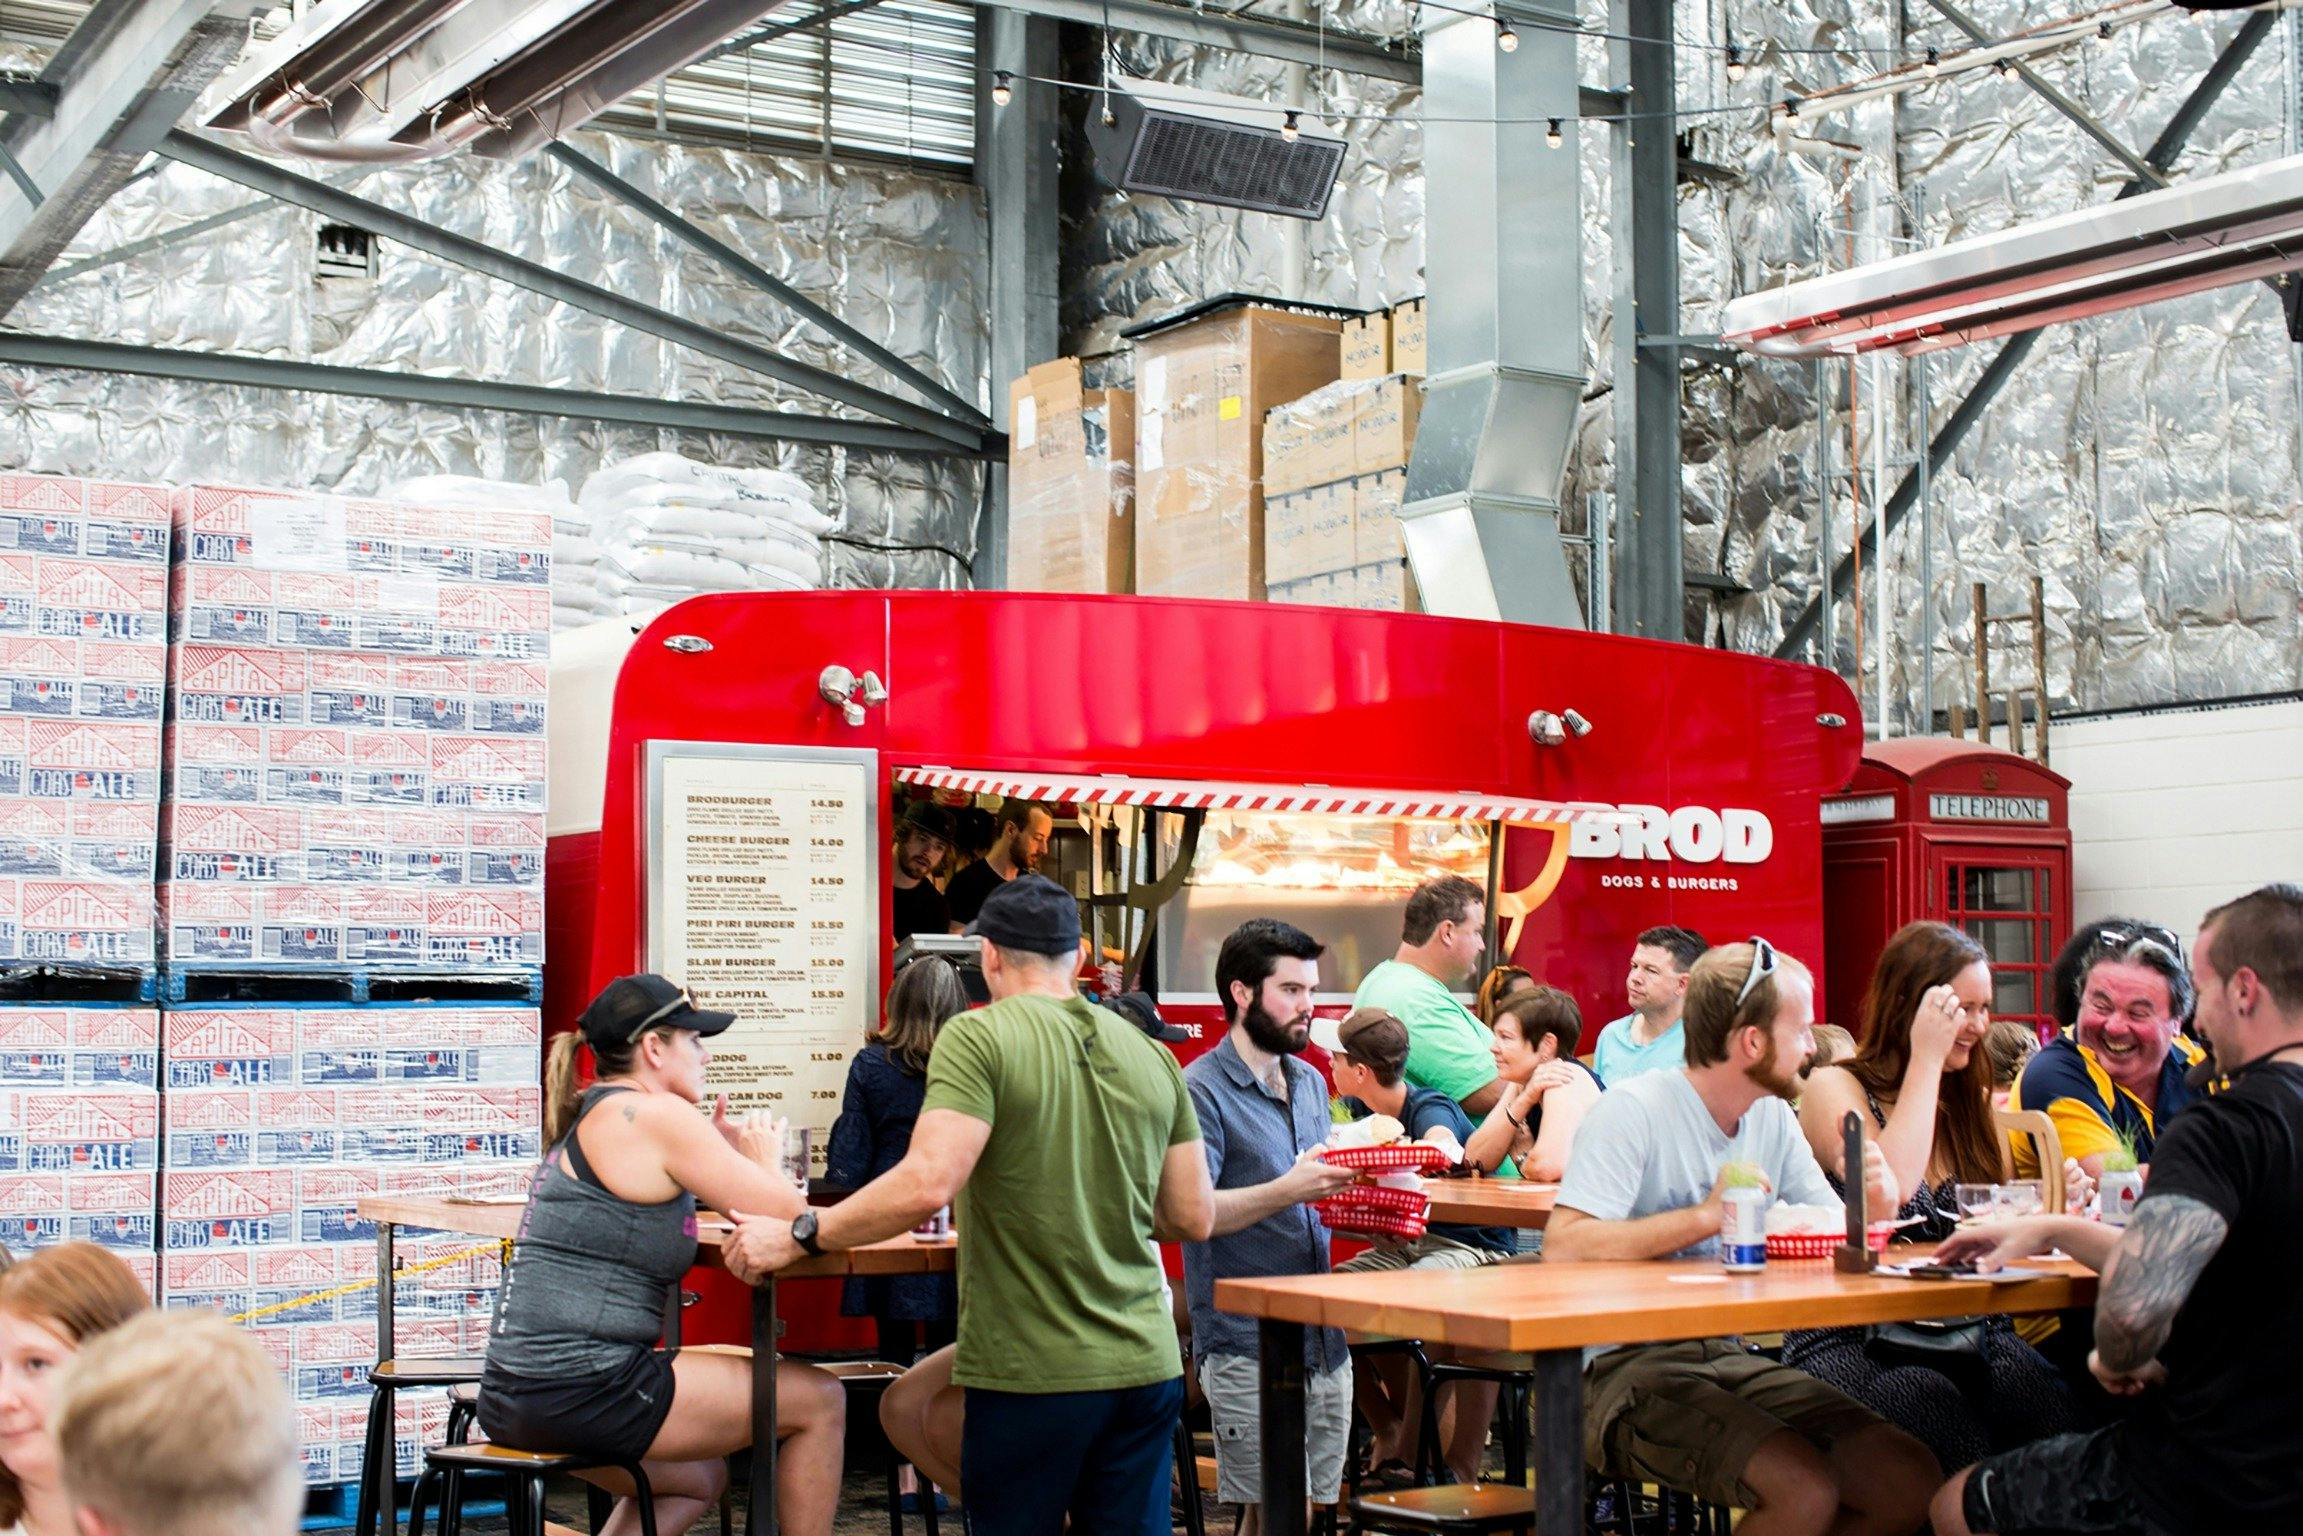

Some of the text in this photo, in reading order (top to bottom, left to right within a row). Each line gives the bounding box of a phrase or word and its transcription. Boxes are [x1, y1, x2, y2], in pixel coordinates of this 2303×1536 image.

[203, 498, 252, 530] CAPI
[50, 568, 133, 608] CAPITAL
[101, 612, 141, 639] ALE
[193, 654, 273, 690] CAPITAL
[243, 697, 282, 722] ALE
[41, 731, 125, 766] CAPITAL
[92, 773, 134, 799] ALE
[687, 795, 772, 806] BRODBURGER
[1936, 796, 2044, 819] TELEPHONE
[188, 812, 270, 849] CAPITAL
[687, 835, 790, 845] CHEESE BURGER
[1566, 801, 1774, 864] BROD
[811, 838, 844, 846] 14.00
[238, 855, 277, 880] ALE
[687, 875, 767, 884] VEG BURGER
[811, 877, 844, 885] 14.50
[1601, 875, 1739, 891] DOGS & BURGERS
[33, 890, 119, 926] CAPITAL
[438, 895, 515, 931] CAPITAL
[687, 919, 795, 929] PIRI PIRI BURGER
[811, 921, 844, 929] 15.50
[85, 933, 128, 959] ALE
[316, 928, 337, 943] ALE
[486, 937, 521, 962] ALE
[687, 958, 776, 967] SLAW BURGER
[811, 958, 844, 966] 15.00
[716, 990, 768, 998] CAPITAL
[811, 990, 844, 998] 15.50
[181, 1019, 263, 1054] CAPITAL
[131, 1055, 154, 1069] ALE
[712, 1054, 747, 1062] DDOG
[811, 1053, 843, 1061] 11.00
[230, 1060, 270, 1086] ALE
[757, 1092, 783, 1100] DOG
[811, 1091, 836, 1099] 7.00
[37, 1102, 123, 1136] CAPITAL
[92, 1144, 131, 1170] ALE
[481, 1135, 518, 1157] ALE
[179, 1178, 263, 1214] CAPITAL
[37, 1218, 60, 1234] ALE
[128, 1216, 151, 1232] ALE
[230, 1220, 269, 1244] ALE
